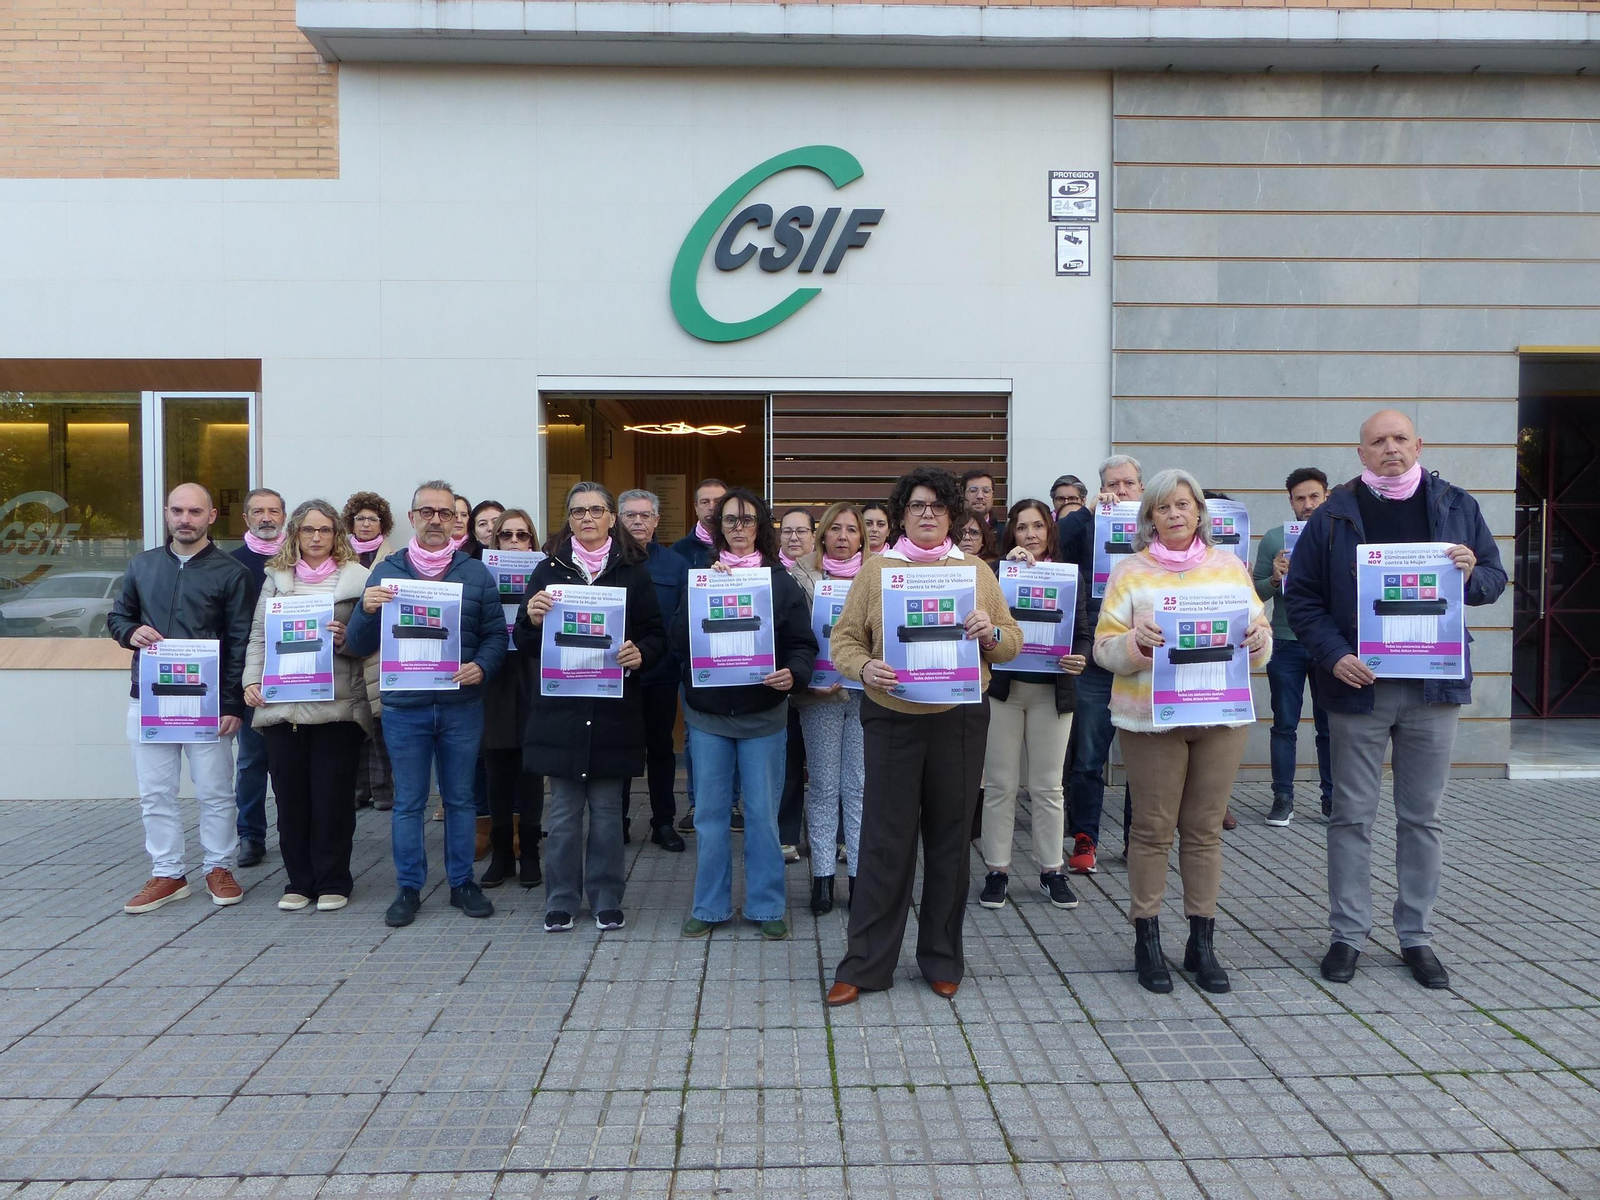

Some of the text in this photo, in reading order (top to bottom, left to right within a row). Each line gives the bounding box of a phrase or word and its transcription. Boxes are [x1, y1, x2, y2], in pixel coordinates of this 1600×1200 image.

[1063, 183, 1087, 192] TSP
[714, 203, 885, 274] CSIF
[0, 522, 82, 556] CSIF
[1369, 551, 1382, 559] 25
[891, 575, 904, 583] 25
[1164, 597, 1177, 605] 25
